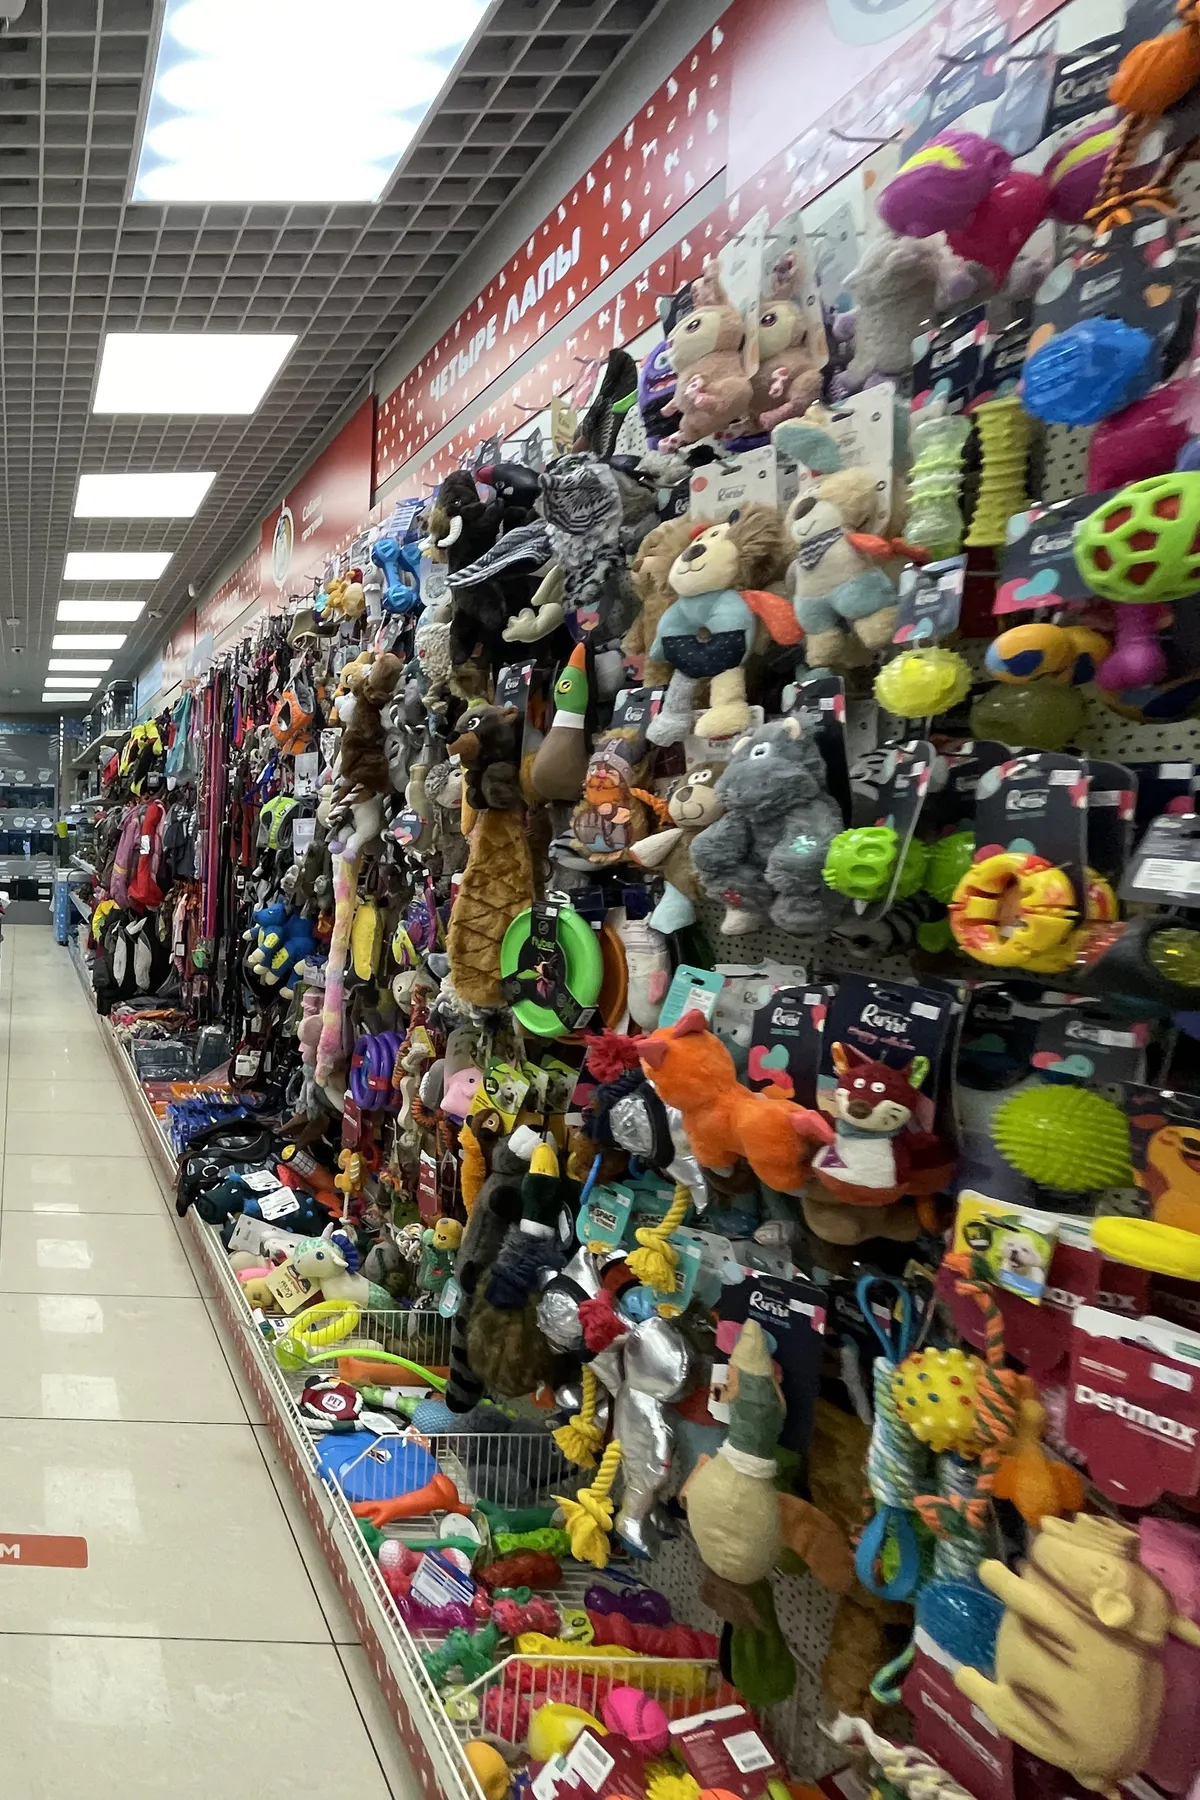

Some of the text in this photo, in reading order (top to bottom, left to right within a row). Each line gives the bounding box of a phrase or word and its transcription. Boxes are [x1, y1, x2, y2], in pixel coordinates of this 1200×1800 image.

[429, 226, 581, 401] ЧЕТЫРЕ ЛАПЫ
[327, 1395, 343, 1407] PET
[1074, 1383, 1199, 1447] petmax
